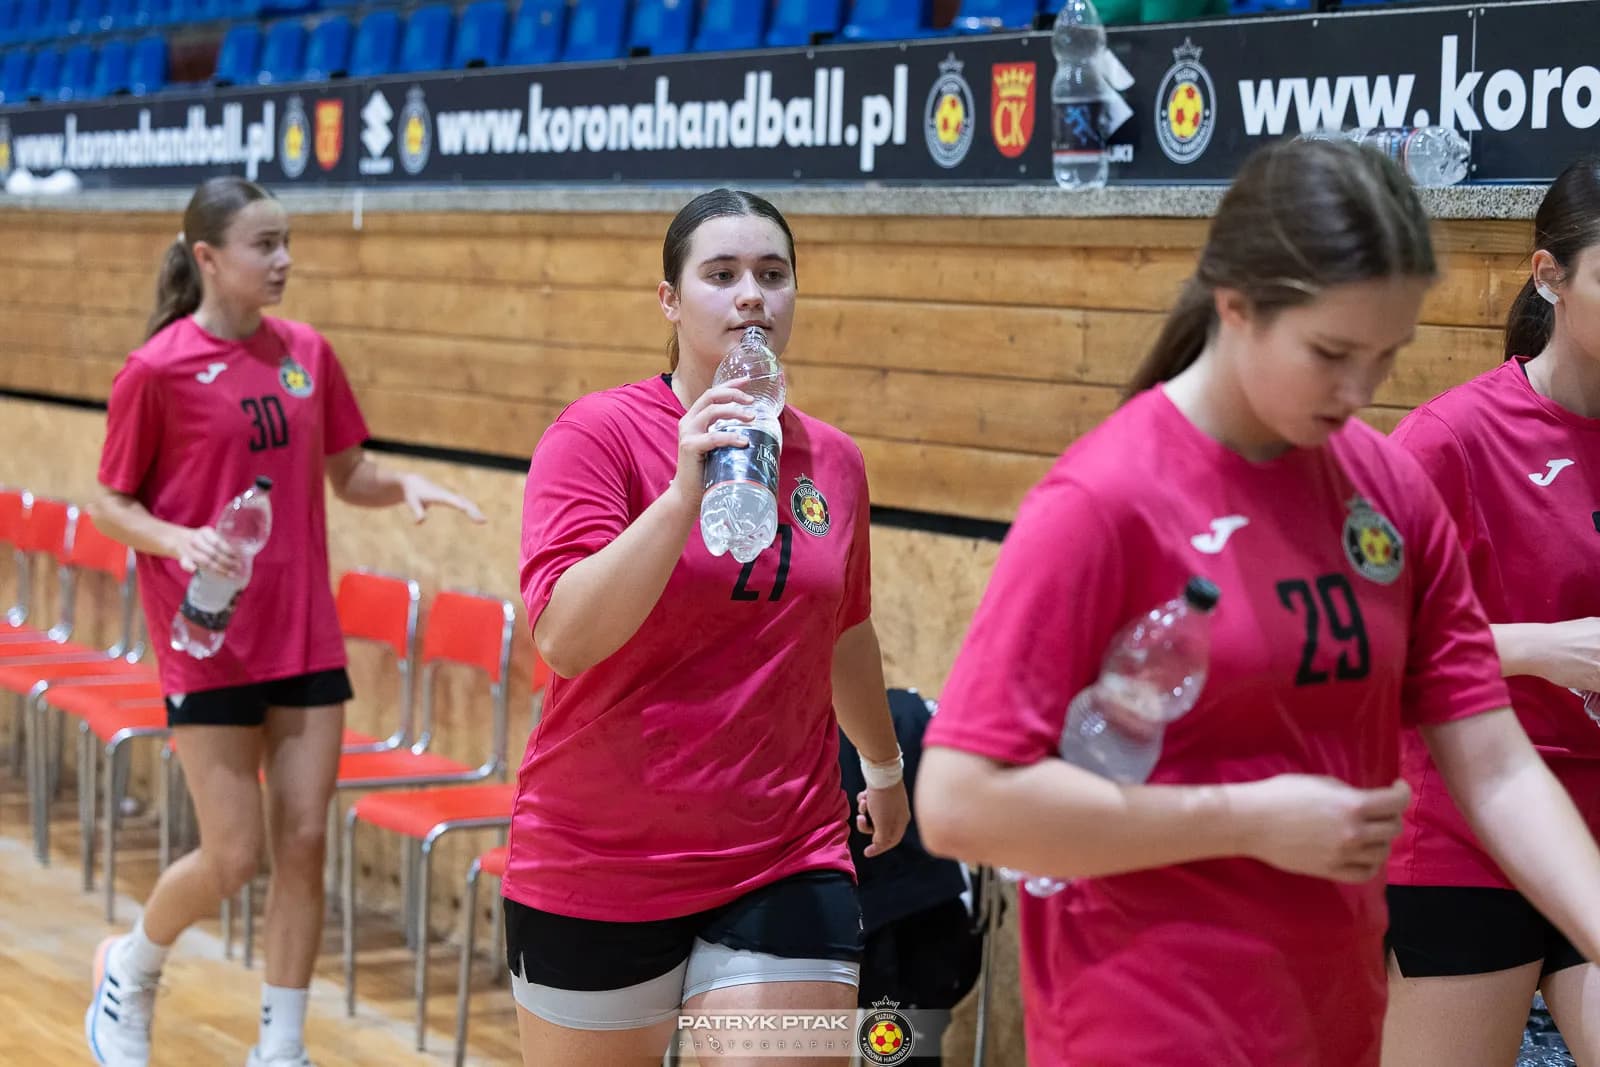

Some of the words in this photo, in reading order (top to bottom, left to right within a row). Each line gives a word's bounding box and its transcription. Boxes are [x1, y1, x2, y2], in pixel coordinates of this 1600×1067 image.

[437, 64, 908, 171] www.koronahandball.pl
[1238, 34, 1600, 136] www.koro
[241, 395, 289, 452] 30
[1275, 572, 1370, 686] 29
